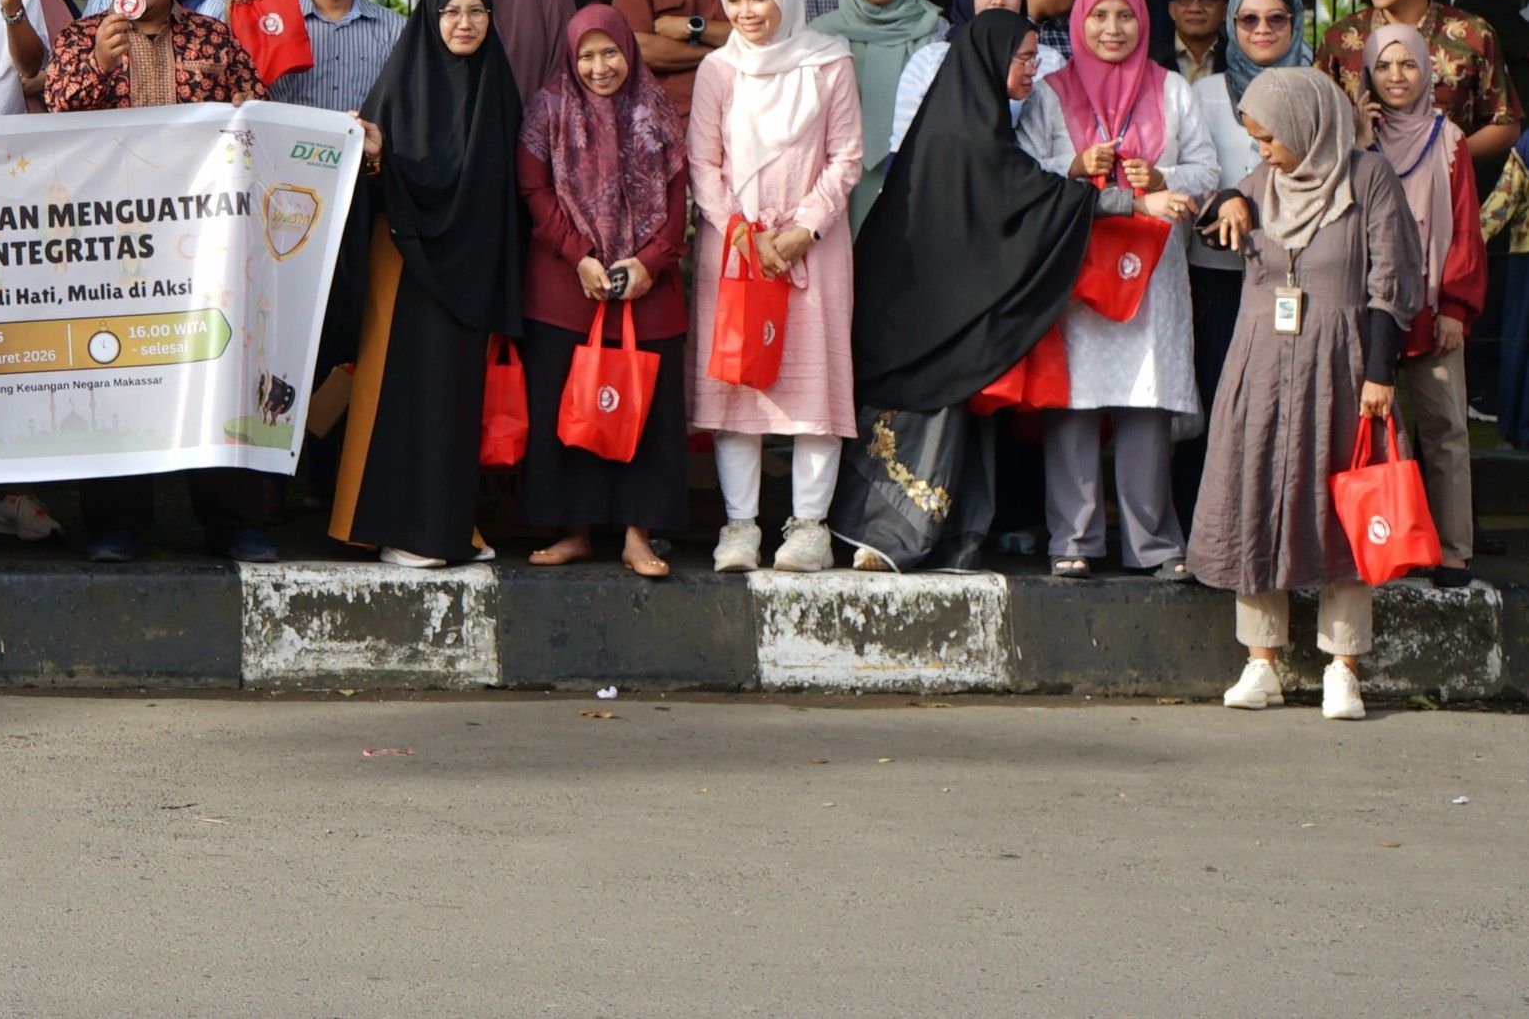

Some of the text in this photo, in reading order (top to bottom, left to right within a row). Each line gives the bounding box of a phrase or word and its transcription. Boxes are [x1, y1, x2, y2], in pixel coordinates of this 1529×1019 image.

[290, 144, 342, 164] DJKN
[48, 192, 251, 228] MENGUATKAN
[16, 286, 63, 305] Hati,
[68, 283, 124, 302] Mulia
[129, 281, 146, 298] di
[152, 279, 192, 297] Aksi
[129, 321, 208, 339] 16.00 WITA
[24, 349, 57, 363] 2026
[140, 339, 189, 356] selesai
[17, 382, 70, 394] Keuangan
[72, 380, 111, 392] Negara
[114, 377, 163, 388] Makassar
